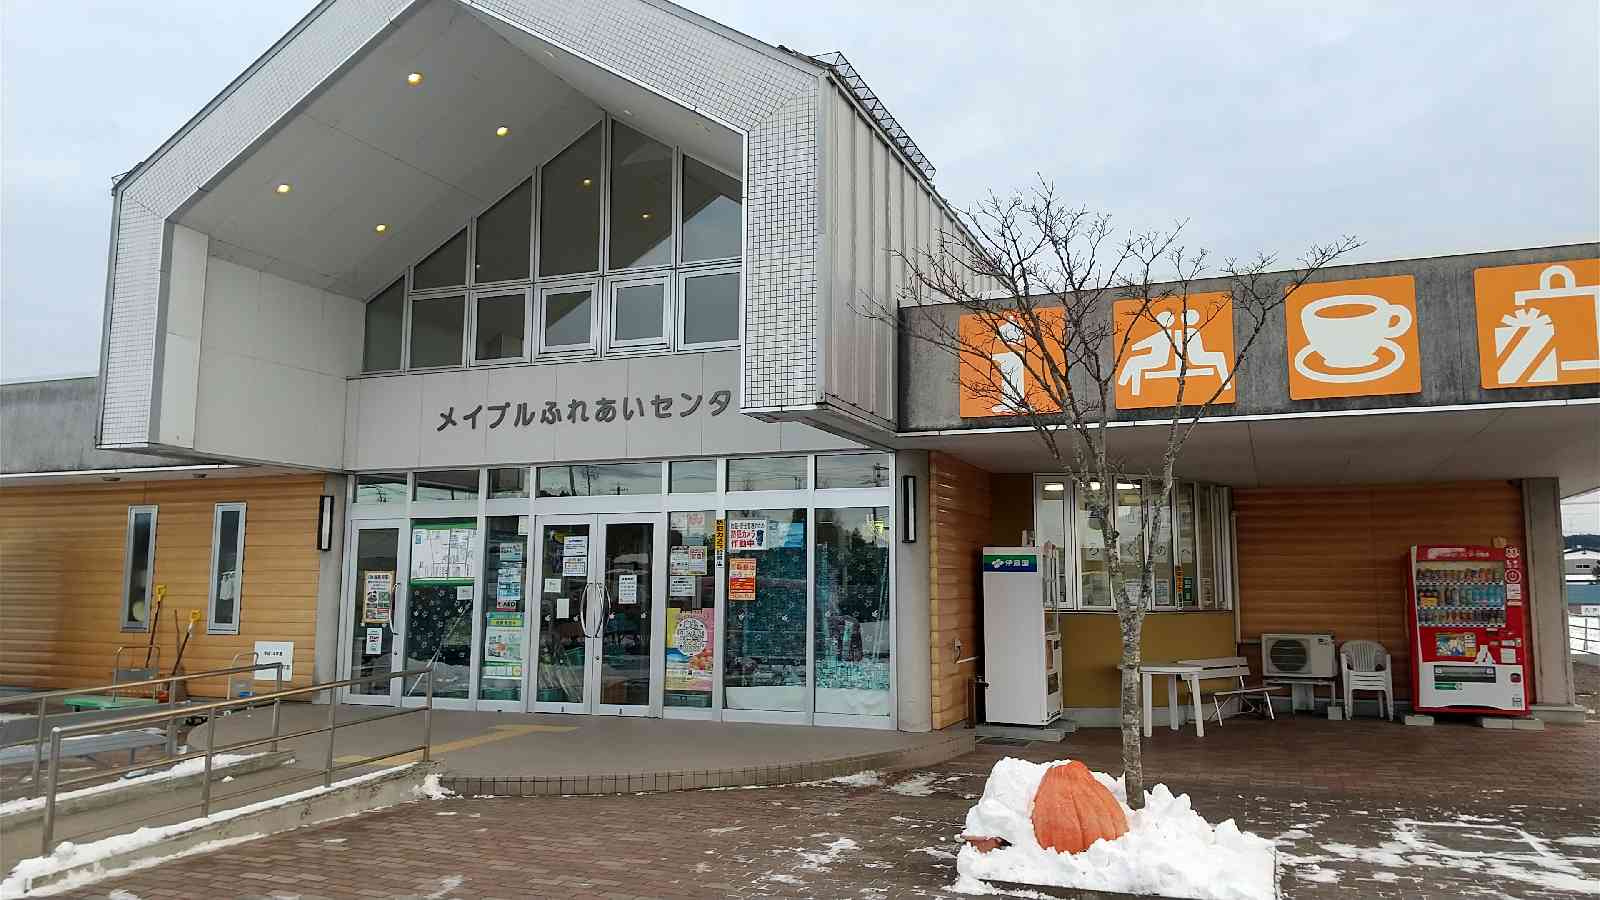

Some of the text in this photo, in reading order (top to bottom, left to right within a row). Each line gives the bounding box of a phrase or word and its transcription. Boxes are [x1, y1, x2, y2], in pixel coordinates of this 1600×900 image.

[437, 390, 731, 432] メイプルふれあいセンタ
